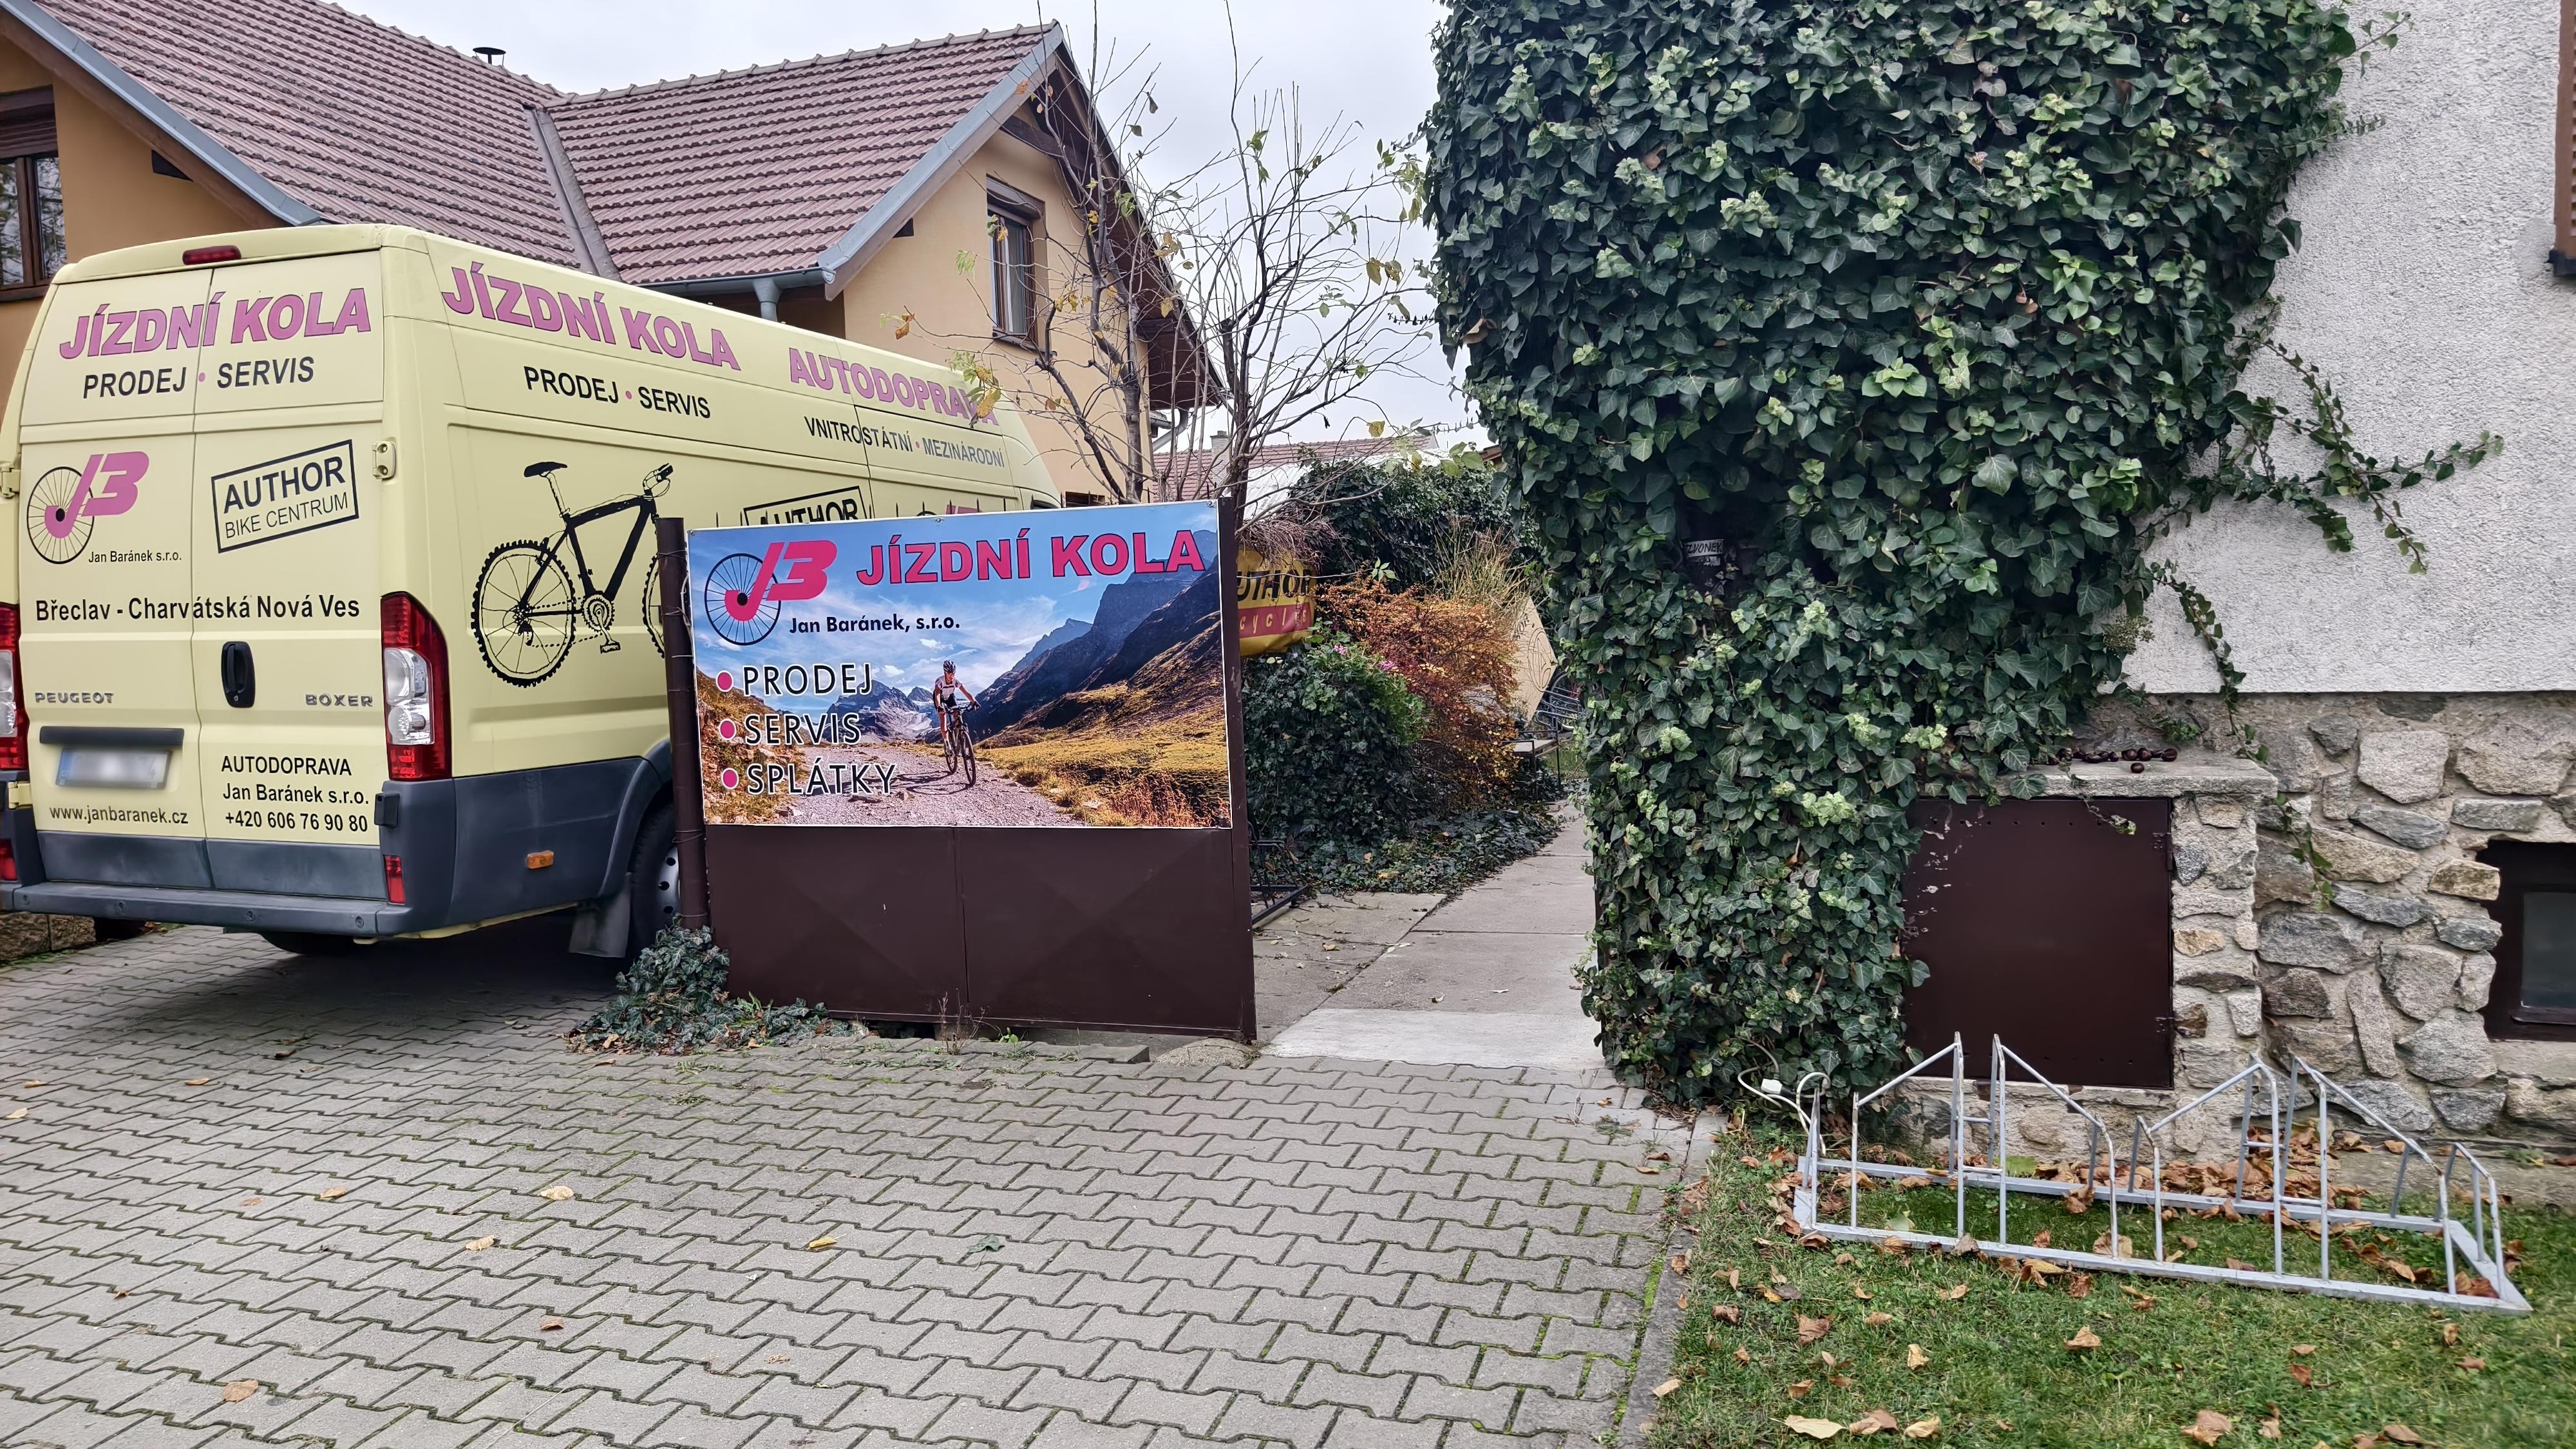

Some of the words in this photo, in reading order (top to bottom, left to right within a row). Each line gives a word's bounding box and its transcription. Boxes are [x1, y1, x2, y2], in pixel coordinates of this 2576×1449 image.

[59, 291, 225, 359] JÍZDNÍ
[231, 288, 371, 343] KOLA
[442, 261, 616, 345] JÍZDNÍ
[620, 306, 741, 371] KOLA
[82, 367, 187, 399] PRODEJ
[217, 356, 315, 388] SERVIS
[524, 366, 619, 404] PRODEJ
[639, 386, 711, 418] SERVIS
[804, 416, 913, 452] VNITROSTÁTNÍ
[922, 437, 1005, 468] MEZINÁRODNÍ
[224, 456, 345, 513] AUTHOR
[225, 520, 261, 539] BIKE
[266, 492, 348, 529] CENTRUM
[88, 551, 107, 564] Jan
[110, 549, 153, 562] Baránek
[156, 553, 182, 561] s.r.o.
[857, 527, 1030, 585] JÍZDNÍ
[1051, 529, 1206, 578] KOLA
[36, 599, 111, 621] Břeclav
[128, 596, 251, 620] Charvátská
[257, 596, 313, 618] Nová
[319, 595, 360, 618] Ves
[789, 618, 820, 634] Jan
[828, 613, 911, 632] Baránek,
[916, 617, 960, 630] s.r.o.
[743, 663, 873, 697] PRODEJ
[35, 692, 115, 705] PEUGEOT
[305, 694, 374, 708] BOXER
[744, 713, 862, 746] SERVIS
[221, 755, 352, 776] AUTODOPRAVA
[747, 757, 896, 795] SPLÁTKY
[223, 783, 252, 800] Jan
[256, 784, 323, 803] Baránek
[328, 790, 369, 804] s.r.o.
[50, 805, 189, 824] www.janbaranek.cz
[225, 811, 262, 829] +420
[267, 811, 296, 829] 606
[300, 813, 320, 830] 76
[324, 814, 343, 831] 90
[348, 815, 368, 833] 80
